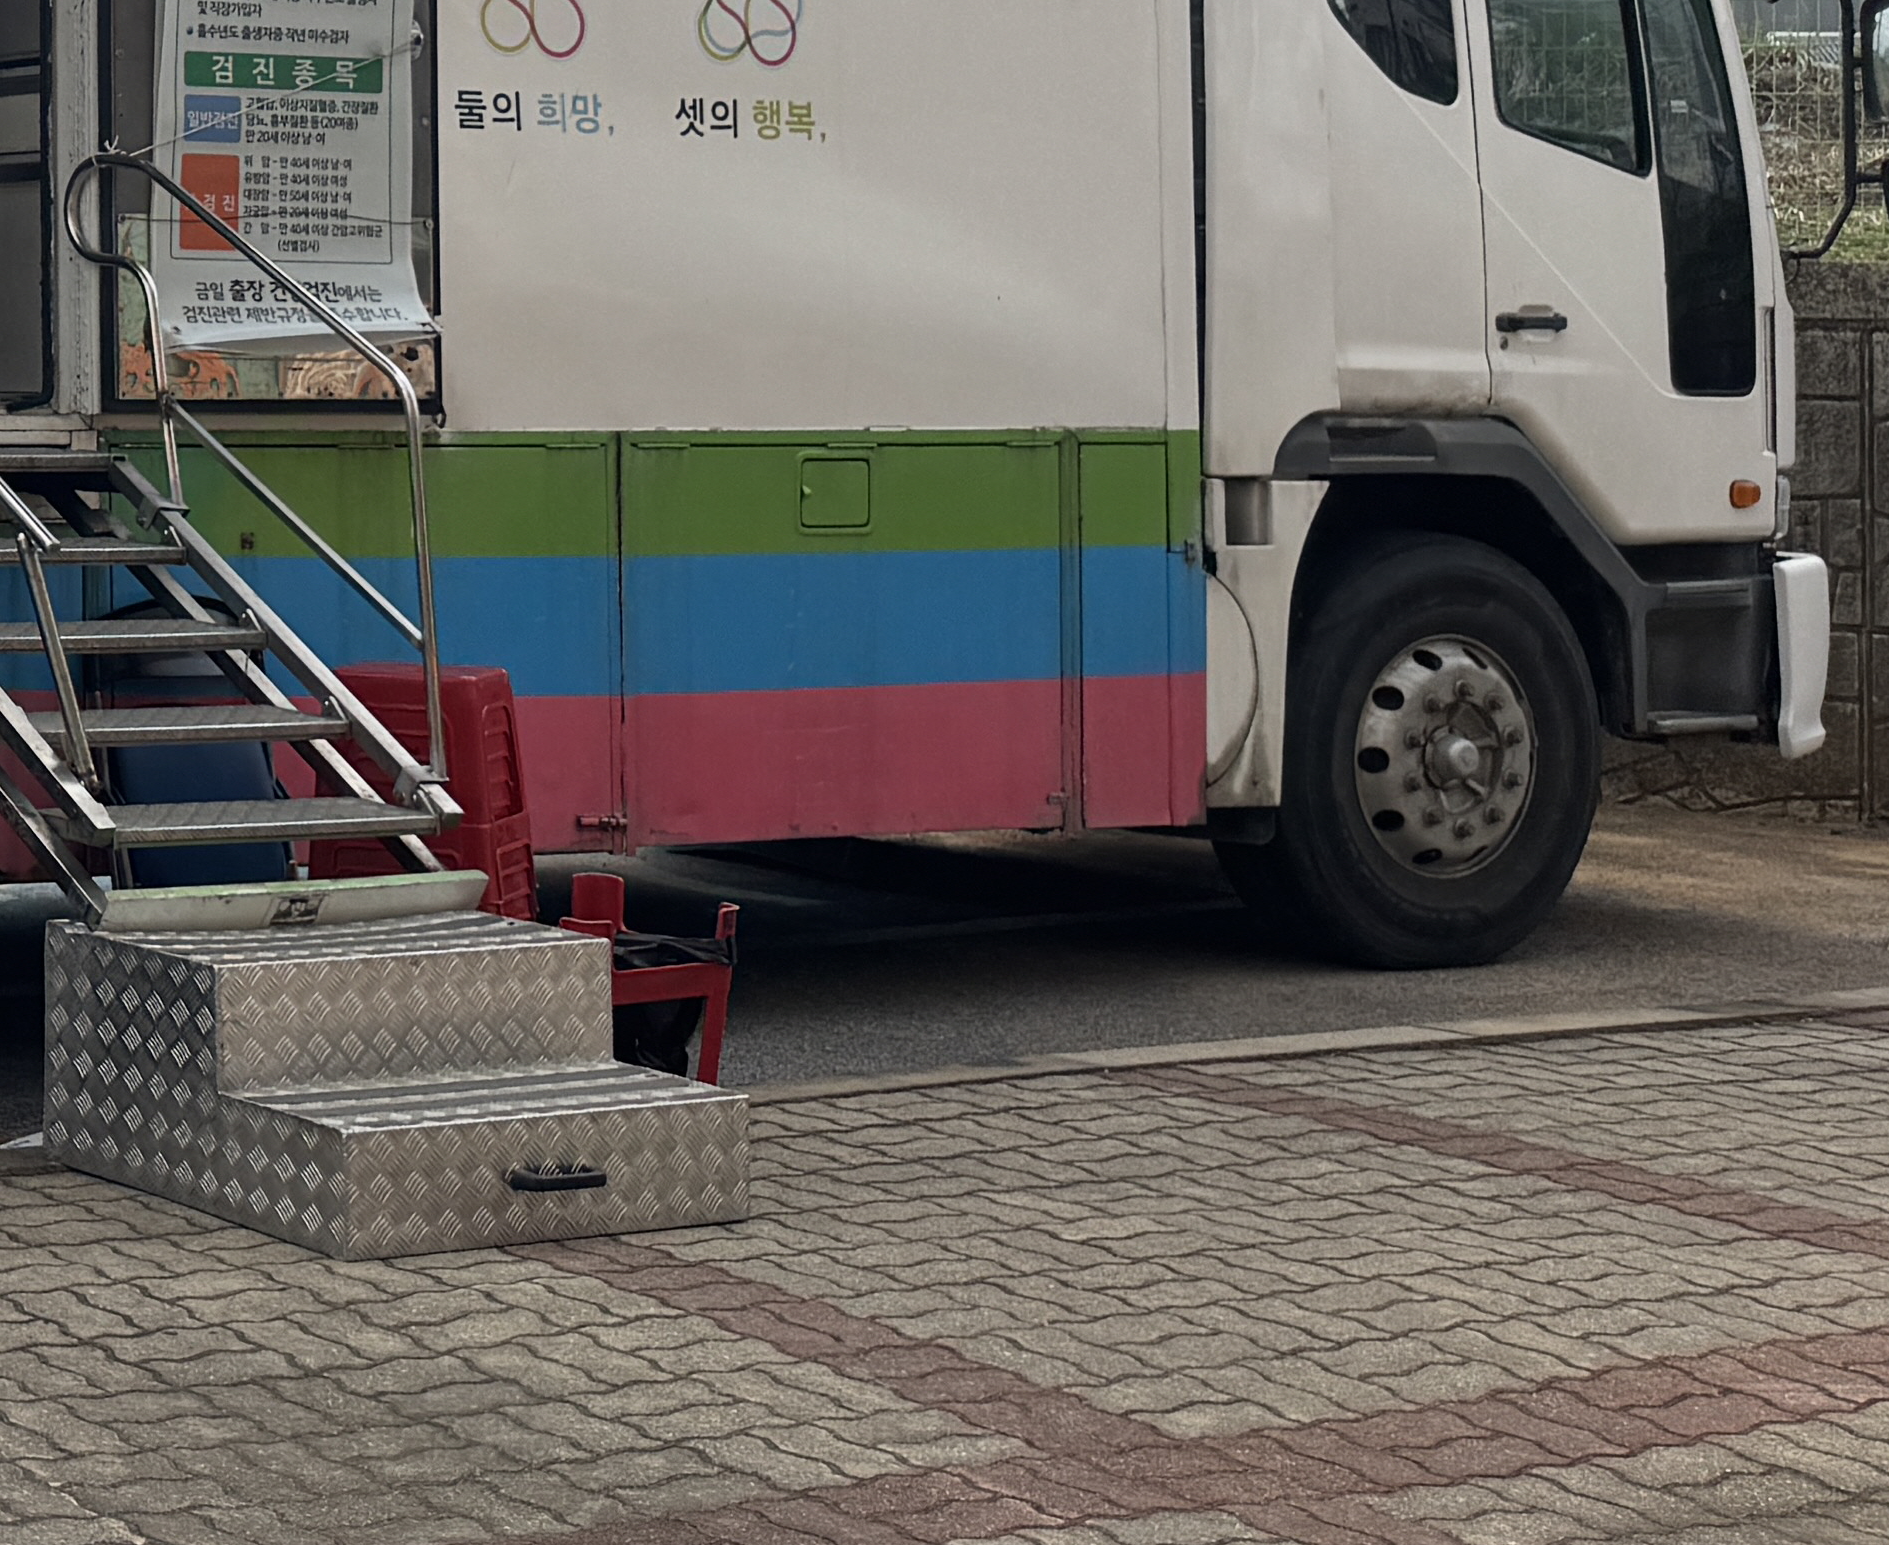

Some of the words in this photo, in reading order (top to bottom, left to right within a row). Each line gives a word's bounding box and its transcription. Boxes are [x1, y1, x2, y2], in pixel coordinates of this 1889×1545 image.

[454, 90, 522, 131] 둘의
[537, 92, 615, 137] 희망,
[675, 98, 739, 139] 셋의
[752, 99, 826, 143] 행복,
[195, 282, 224, 301] 금일
[229, 279, 265, 302] 출장
[182, 305, 243, 324] 검진관련
